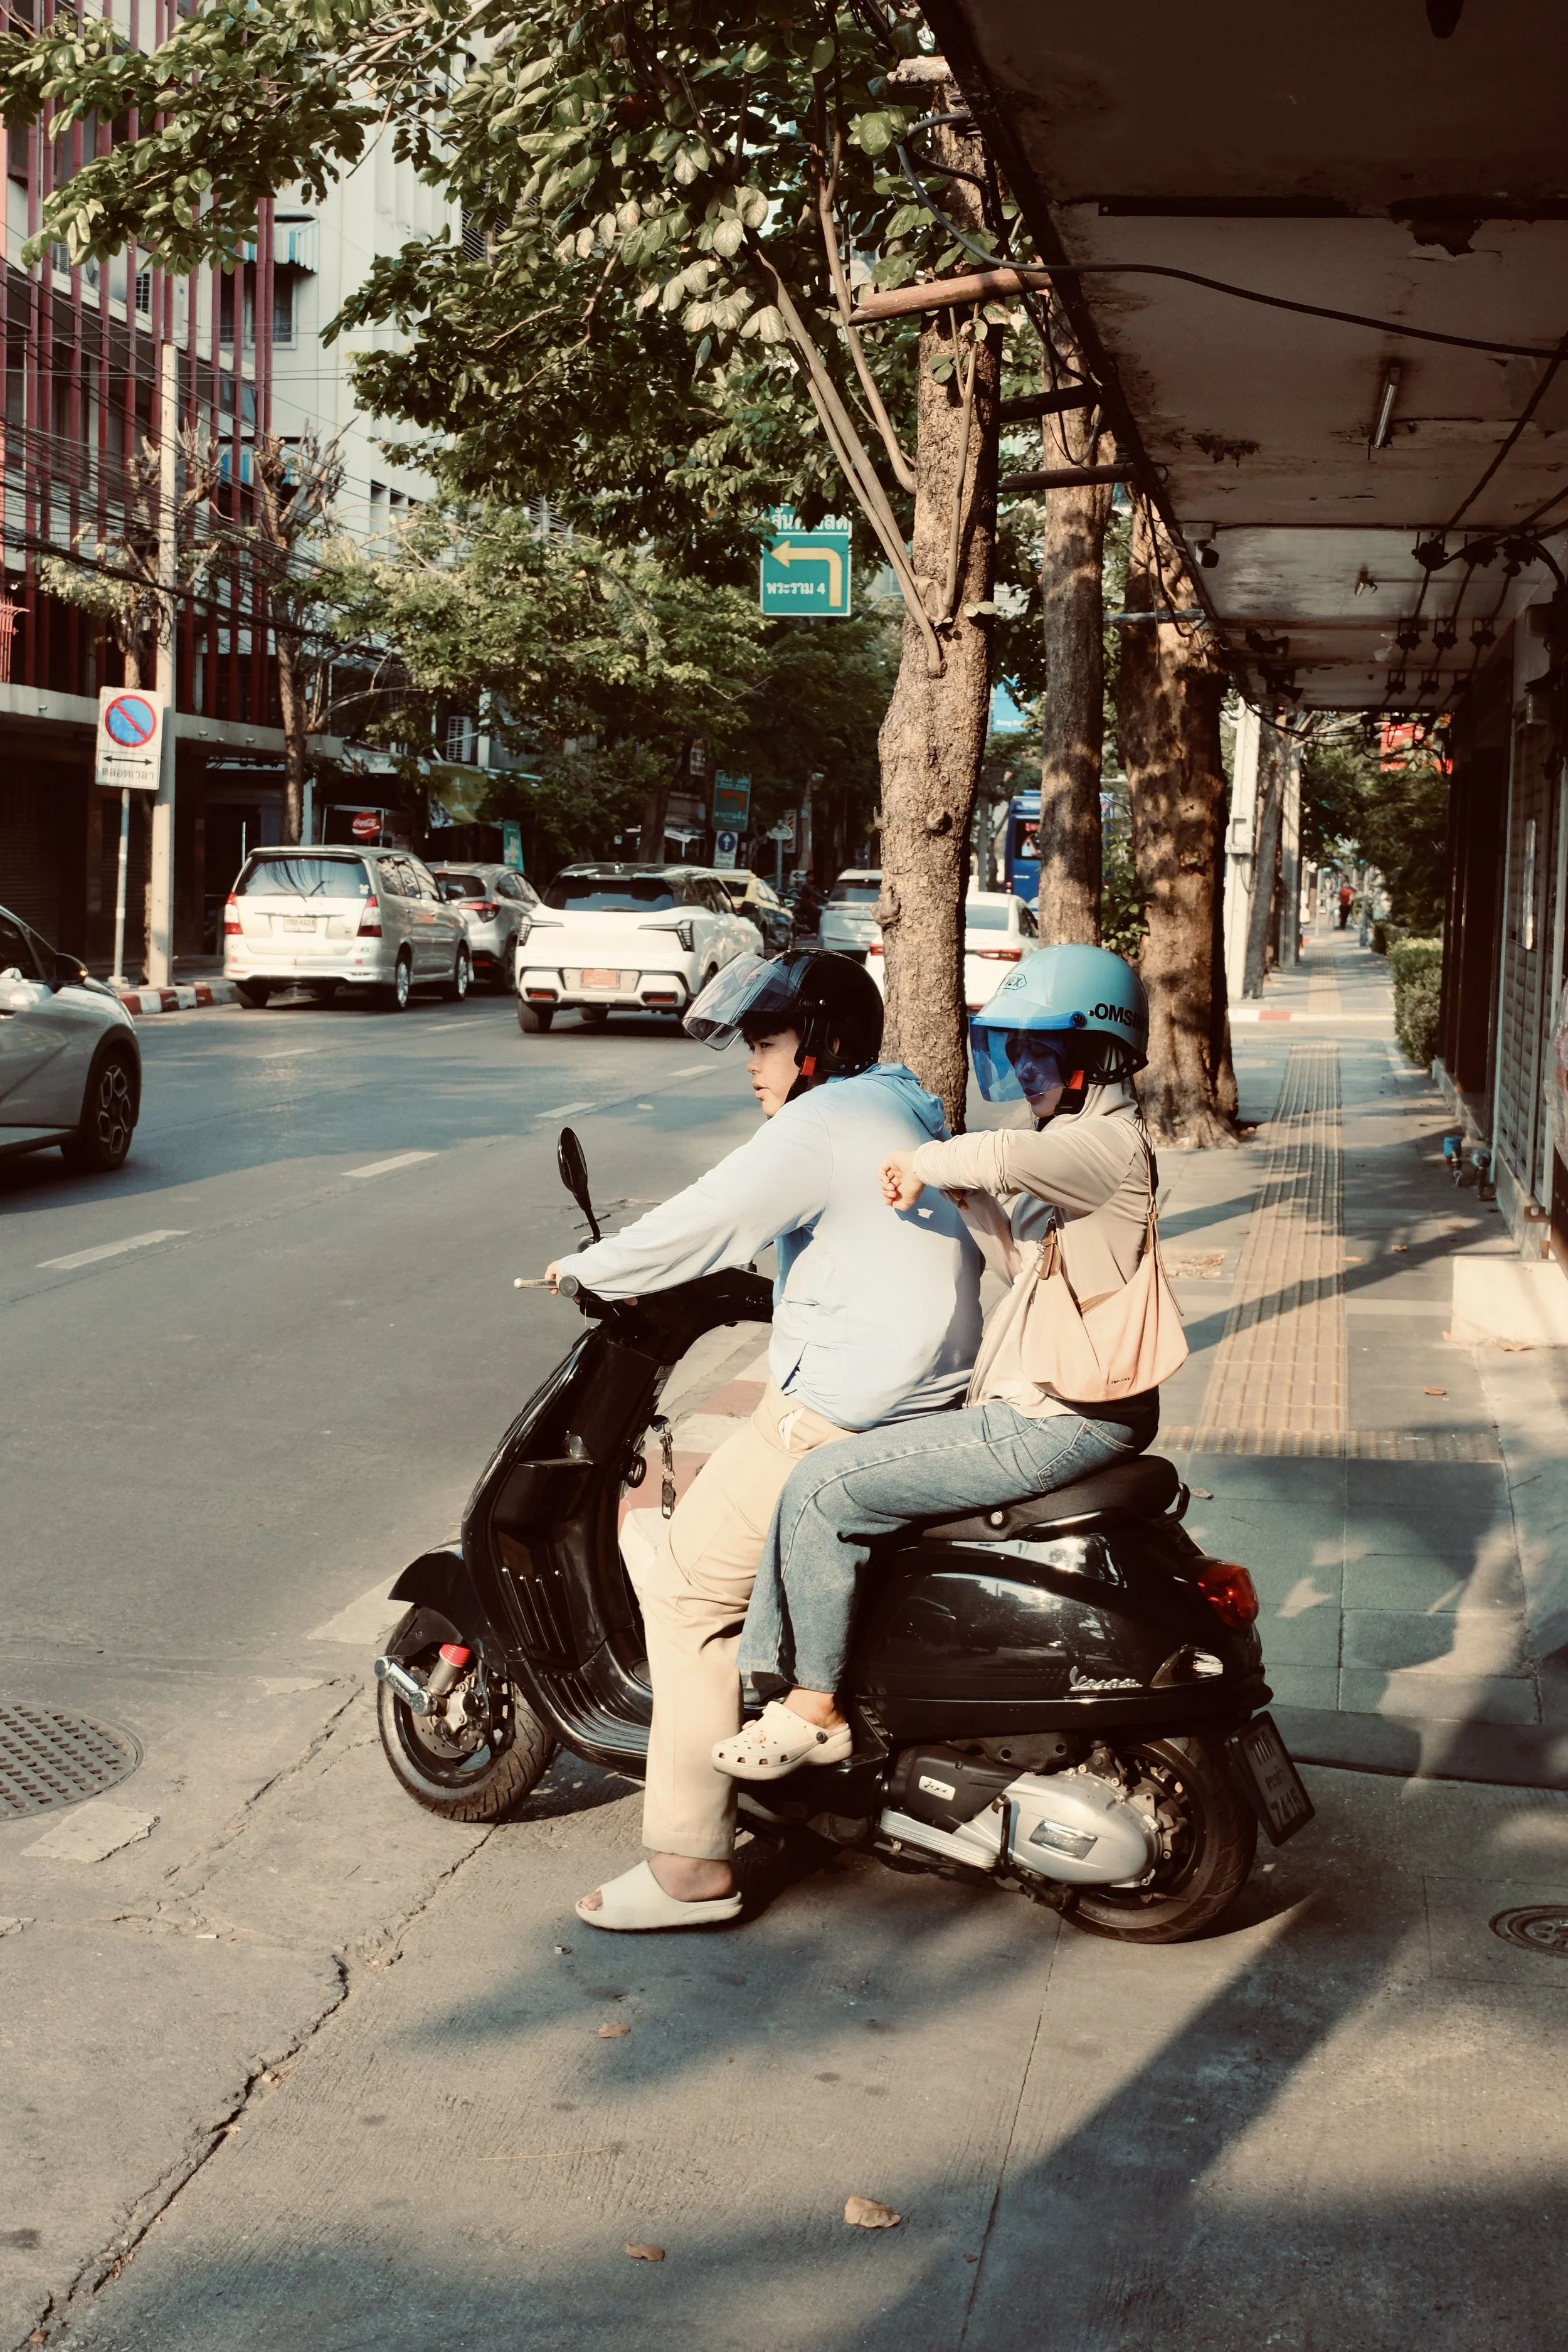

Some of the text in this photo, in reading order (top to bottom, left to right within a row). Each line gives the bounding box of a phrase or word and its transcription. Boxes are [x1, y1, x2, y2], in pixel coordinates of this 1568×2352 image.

[766, 582, 826, 595] พระราม 4
[102, 767, 154, 781] ตลอดเวลา
